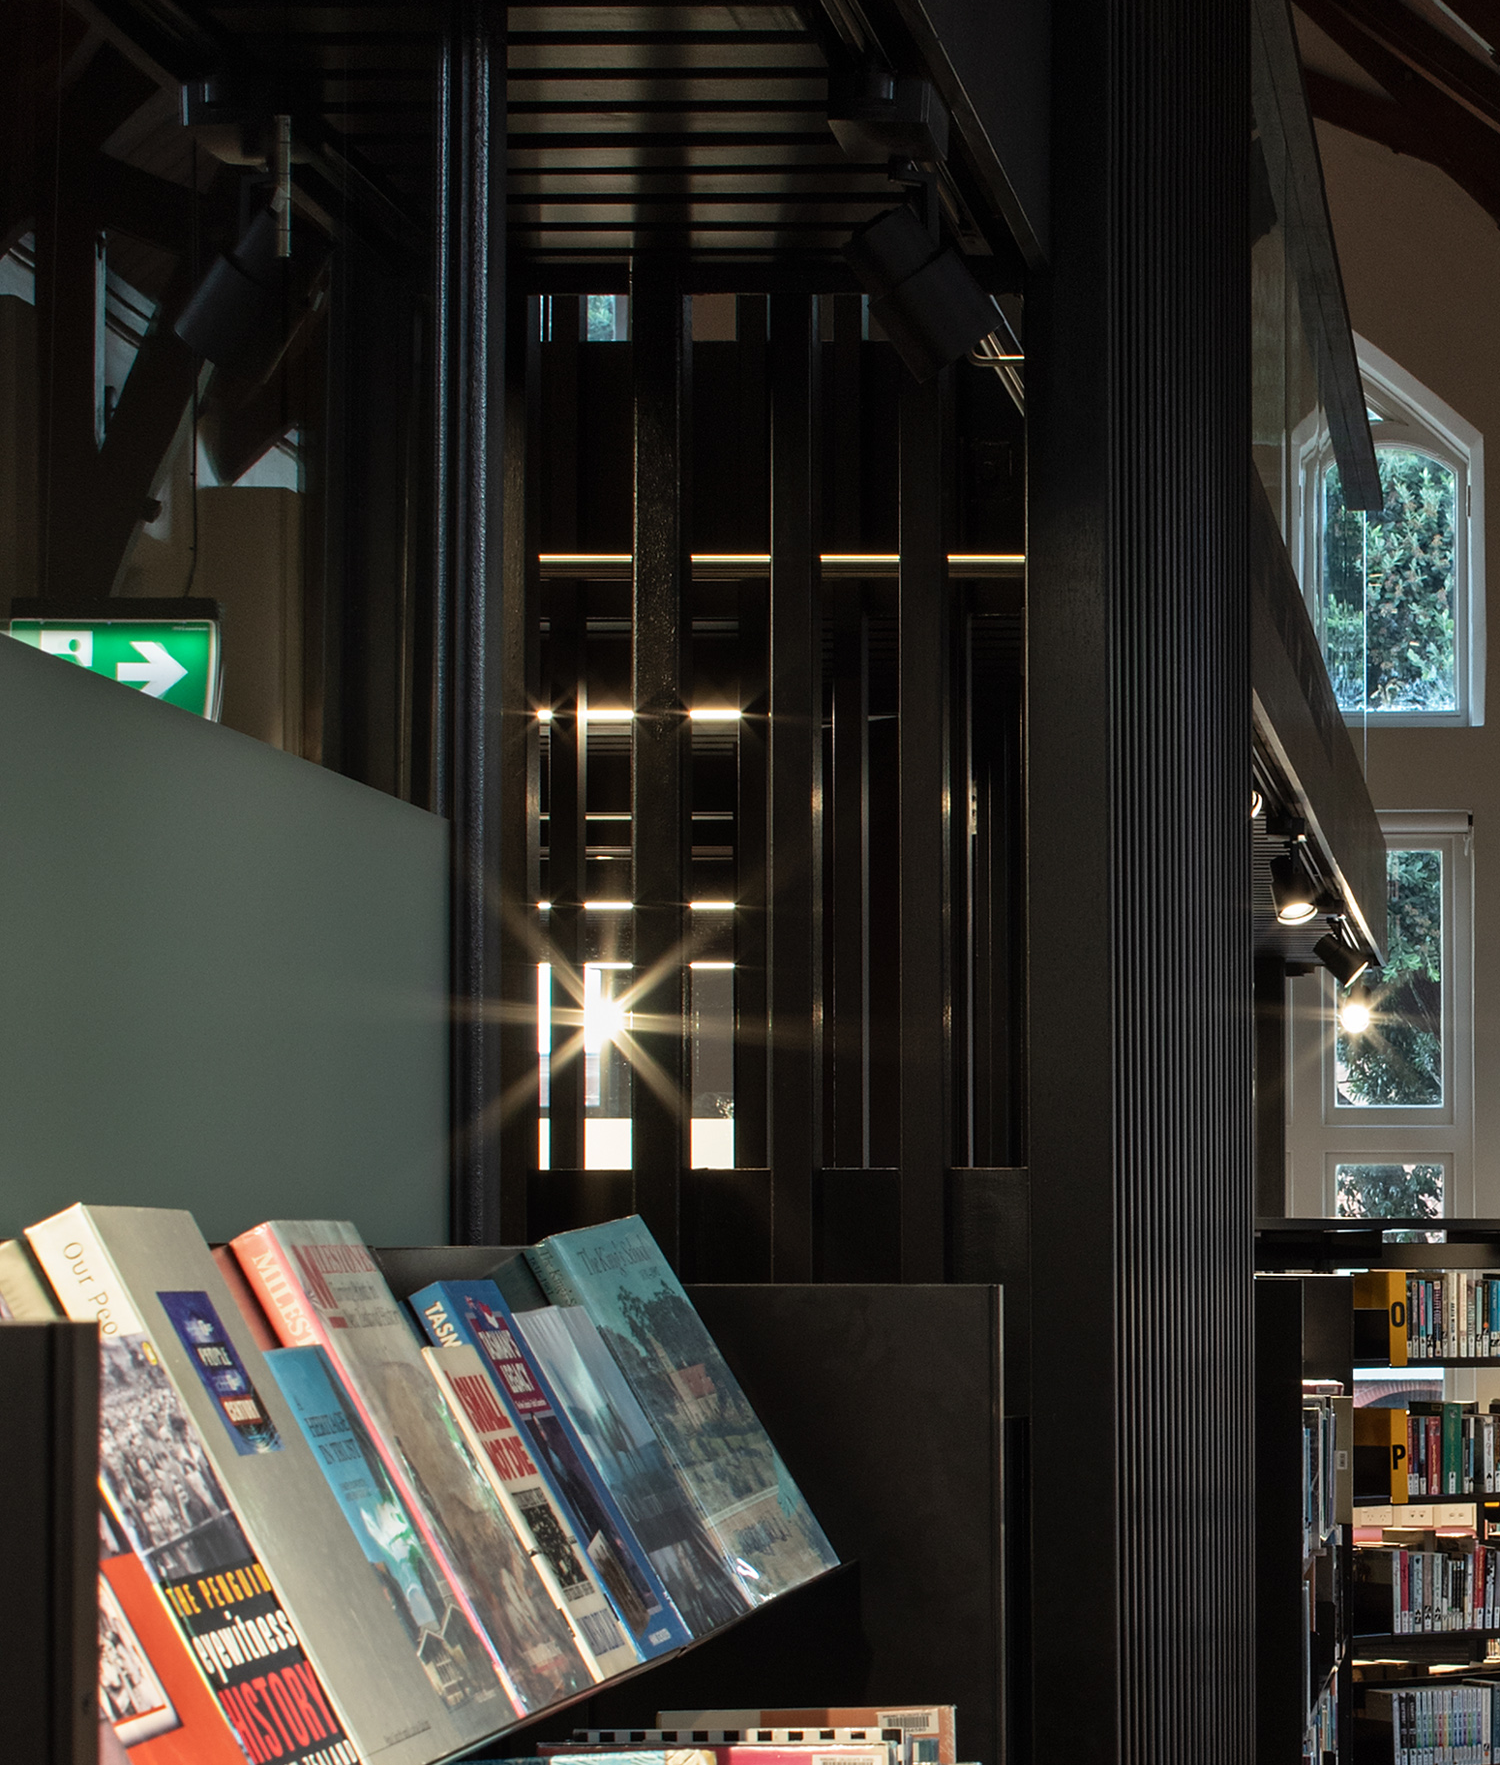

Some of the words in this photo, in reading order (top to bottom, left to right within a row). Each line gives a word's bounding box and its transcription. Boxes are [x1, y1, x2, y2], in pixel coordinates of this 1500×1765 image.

[63, 1241, 94, 1285] Our
[1391, 1301, 1405, 1328] O
[197, 1346, 233, 1366] PEOPLE
[454, 1374, 512, 1433] SHALL
[1392, 1444, 1406, 1470] P
[165, 1583, 200, 1617] THE
[197, 1563, 272, 1609] PENGUIN
[192, 1609, 299, 1684] eyewitness
[218, 1660, 338, 1765] HISTORY
